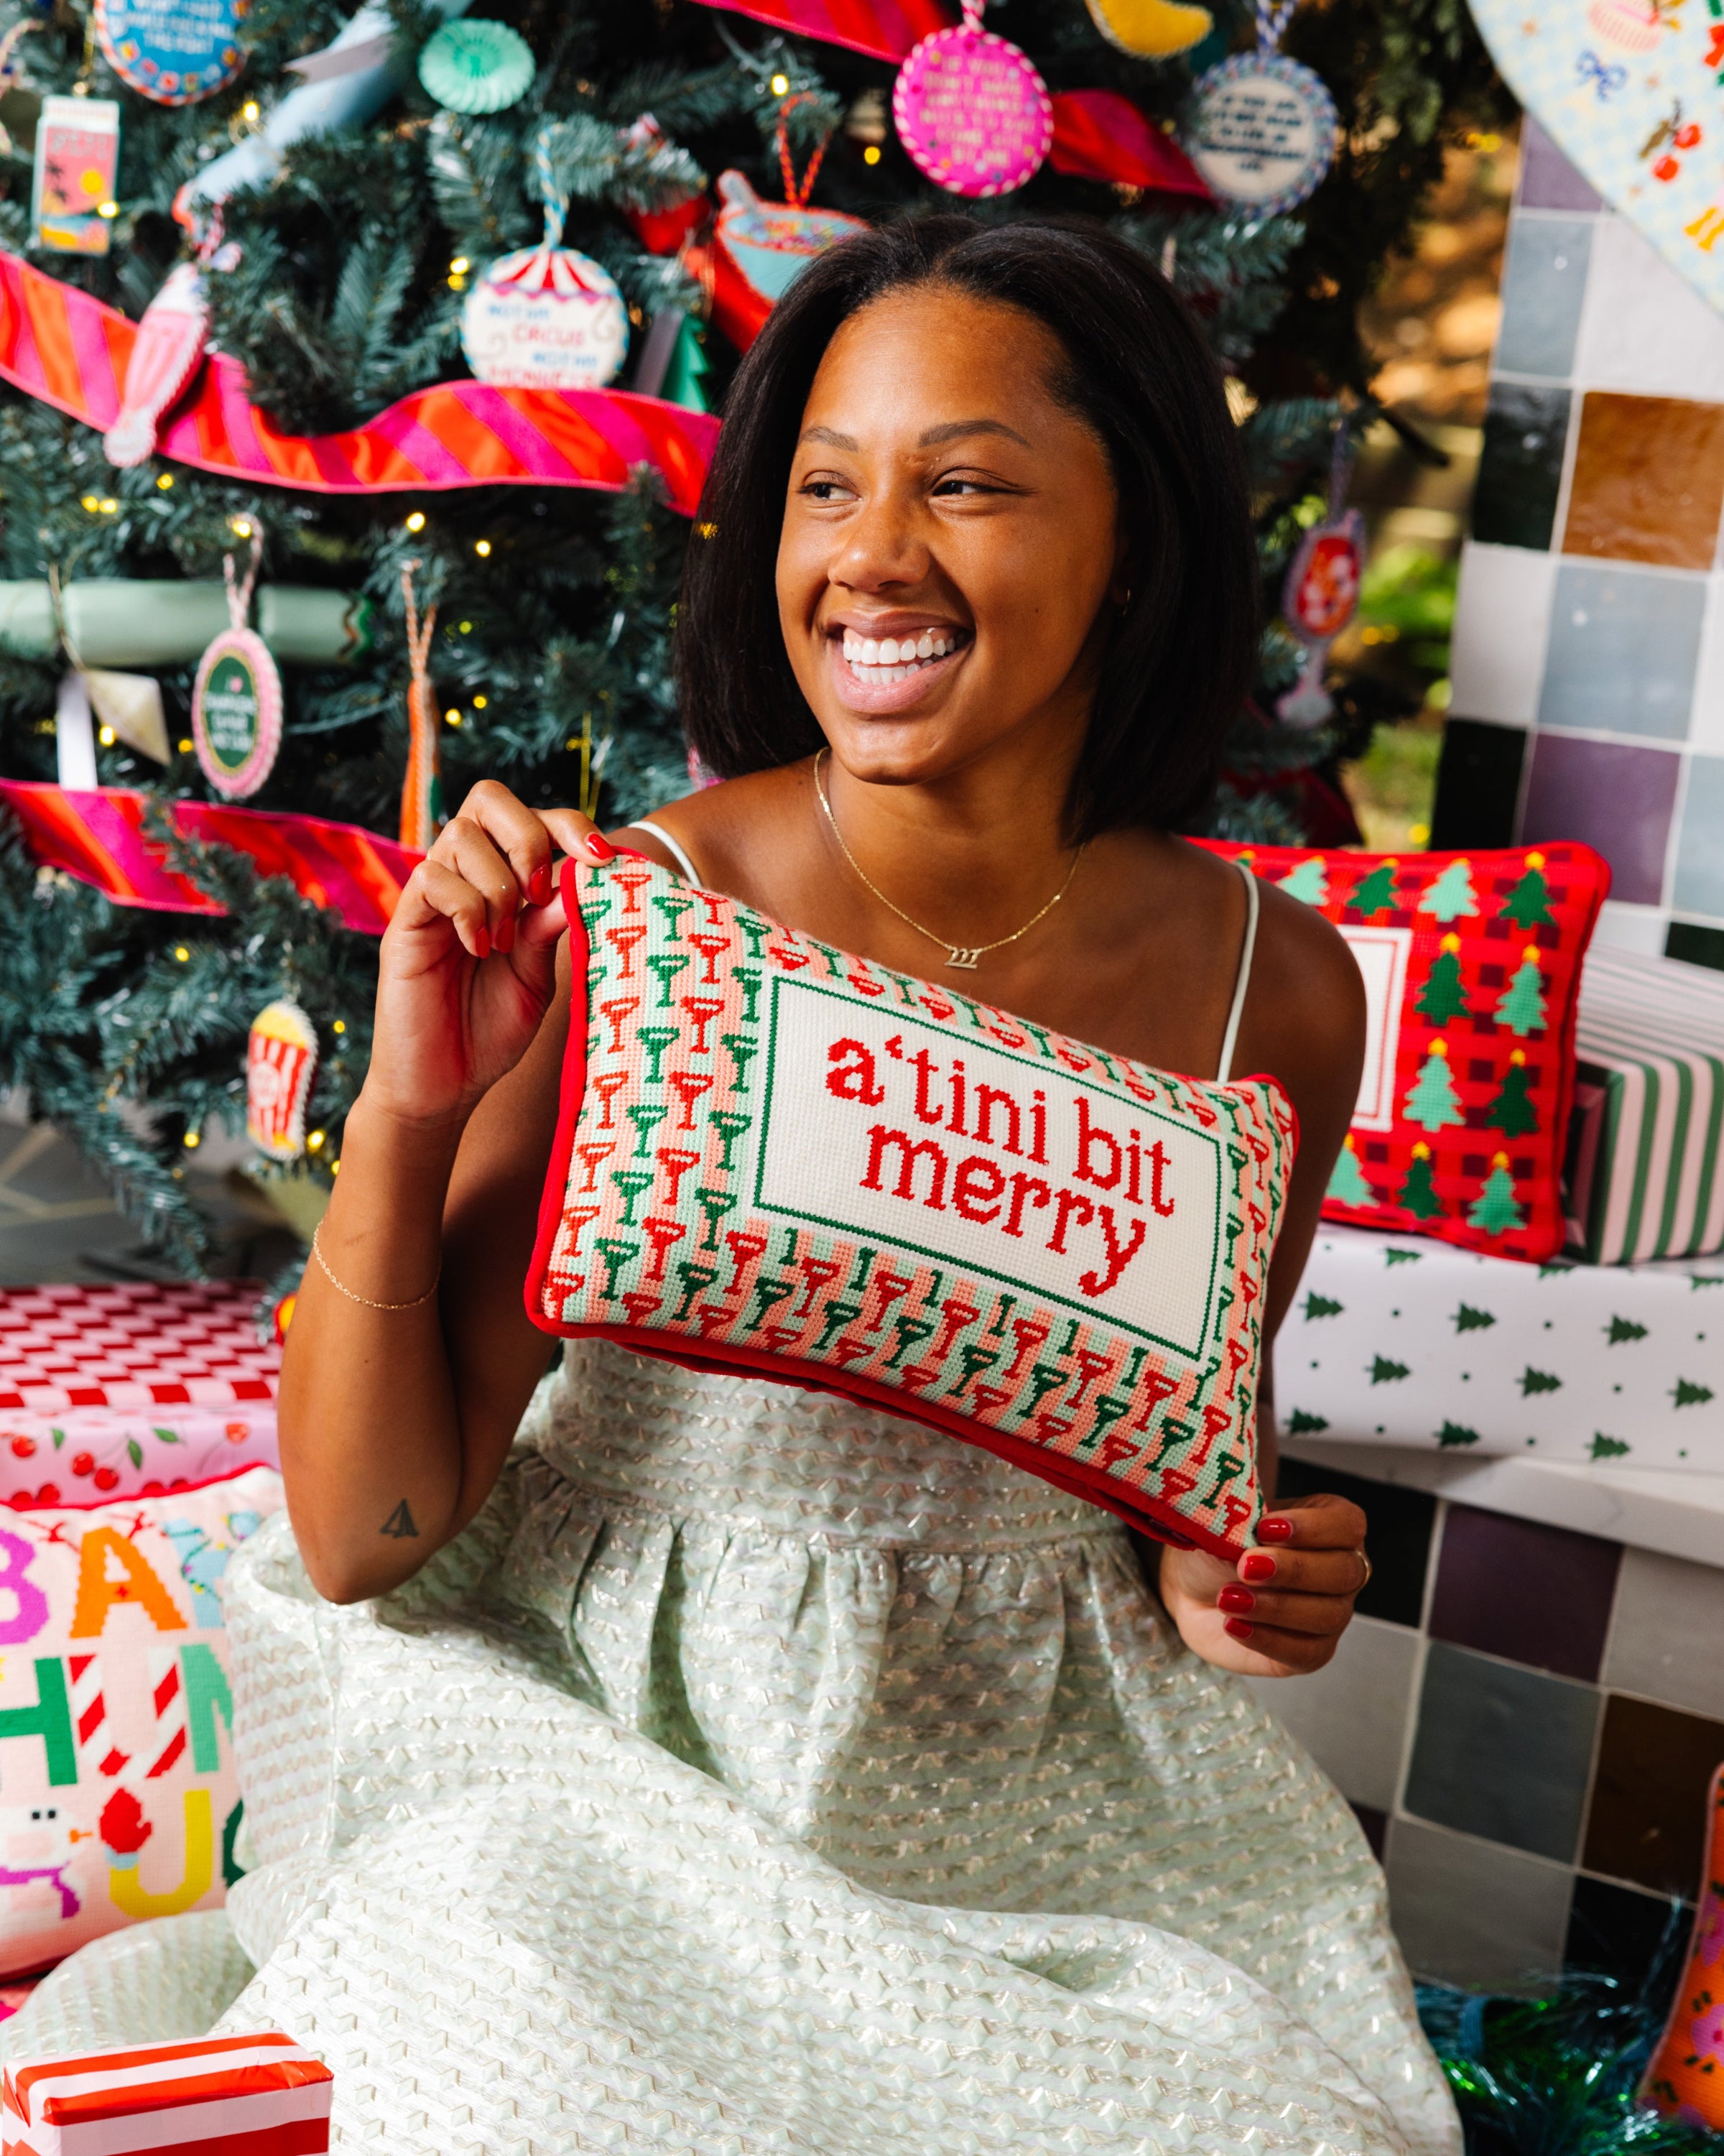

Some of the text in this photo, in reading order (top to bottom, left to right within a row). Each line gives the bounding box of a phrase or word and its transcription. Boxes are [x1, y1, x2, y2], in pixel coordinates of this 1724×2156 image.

[513, 324, 584, 348] CIRCUS
[859, 1124, 1146, 1297] merry
[1072, 1096, 1174, 1217] bit
